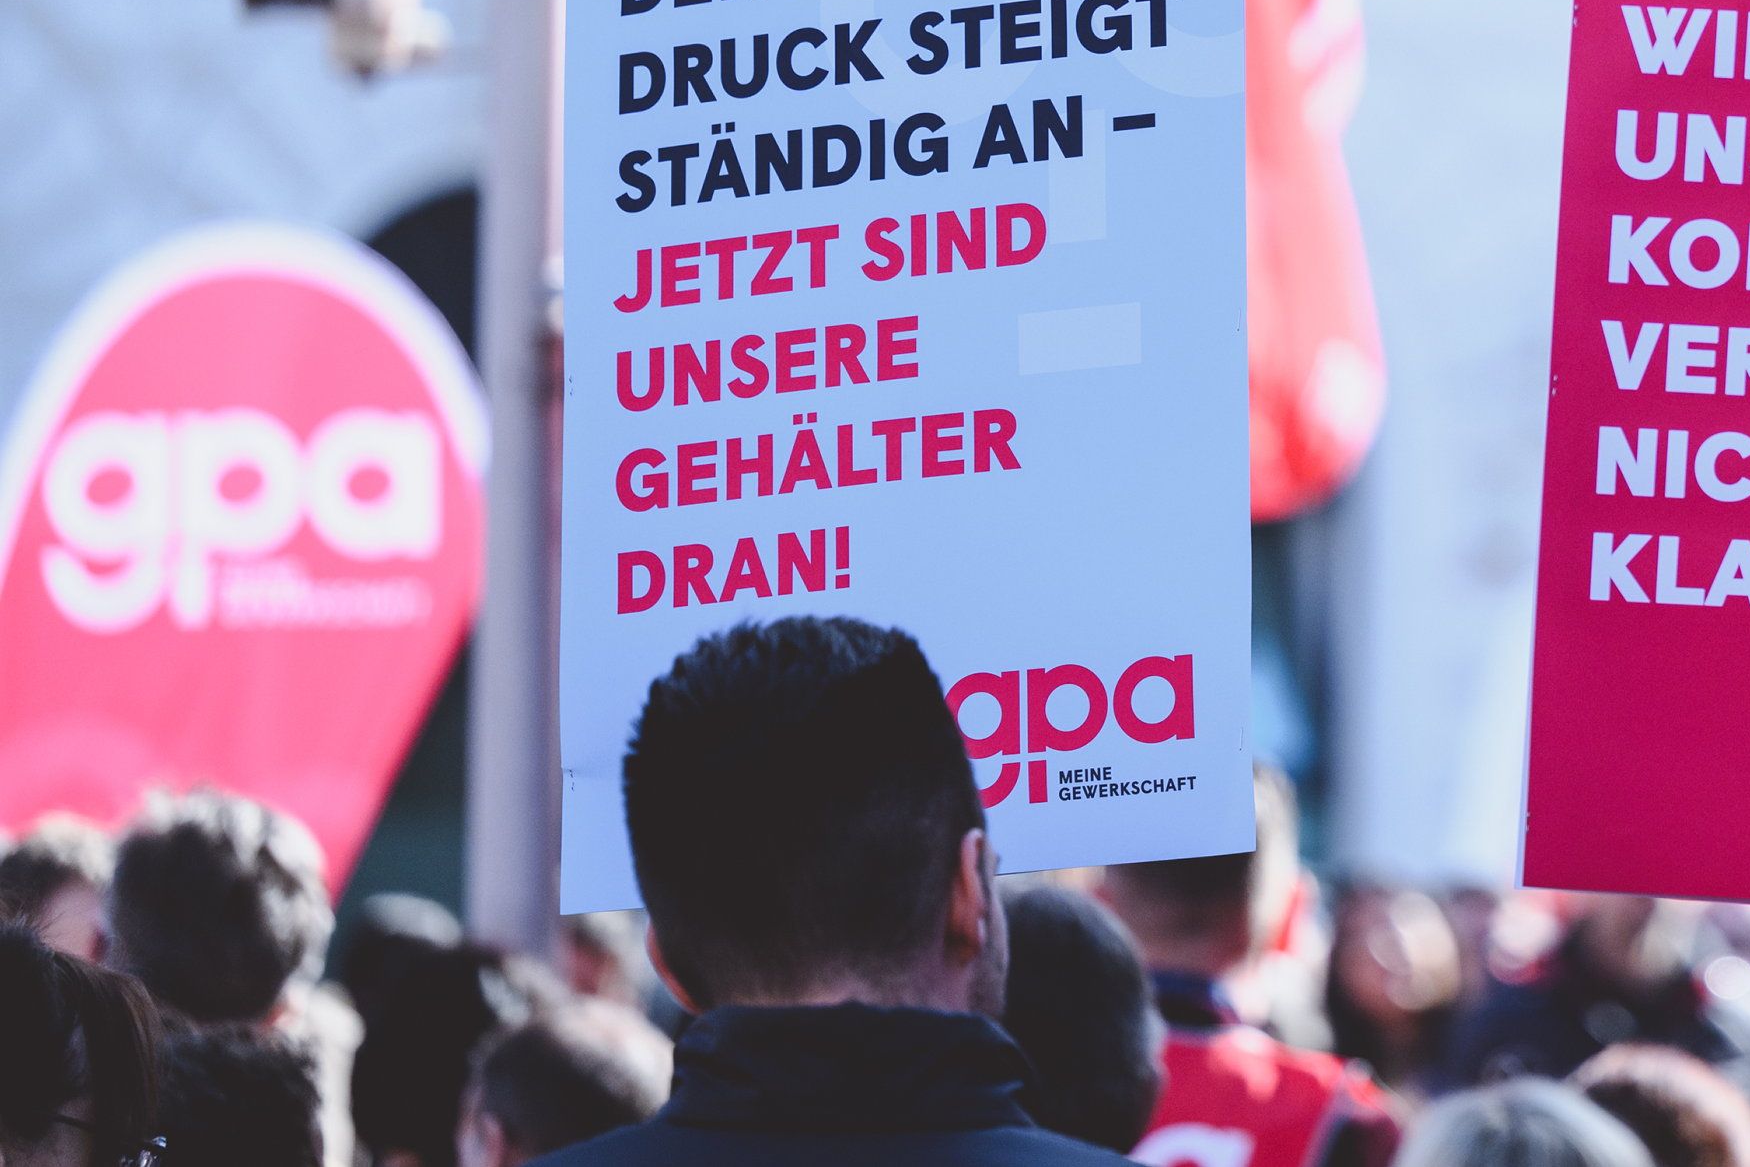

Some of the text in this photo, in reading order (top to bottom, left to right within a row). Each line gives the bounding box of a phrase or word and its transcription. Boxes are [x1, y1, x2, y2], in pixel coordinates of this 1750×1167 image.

[618, 18, 885, 115] DRUCK
[614, 112, 950, 214] STÄNDIG
[972, 94, 1085, 169] AN
[612, 201, 1048, 314] JETZT SIND
[616, 315, 920, 413] UNSERE
[614, 408, 1022, 513] GEHÄLTER
[40, 407, 443, 634] gpa
[616, 525, 852, 615] DRAN!
[944, 654, 1196, 810] gpa
[1058, 766, 1113, 785] MEINE
[1058, 775, 1197, 802] GEWERKSCHAFT
